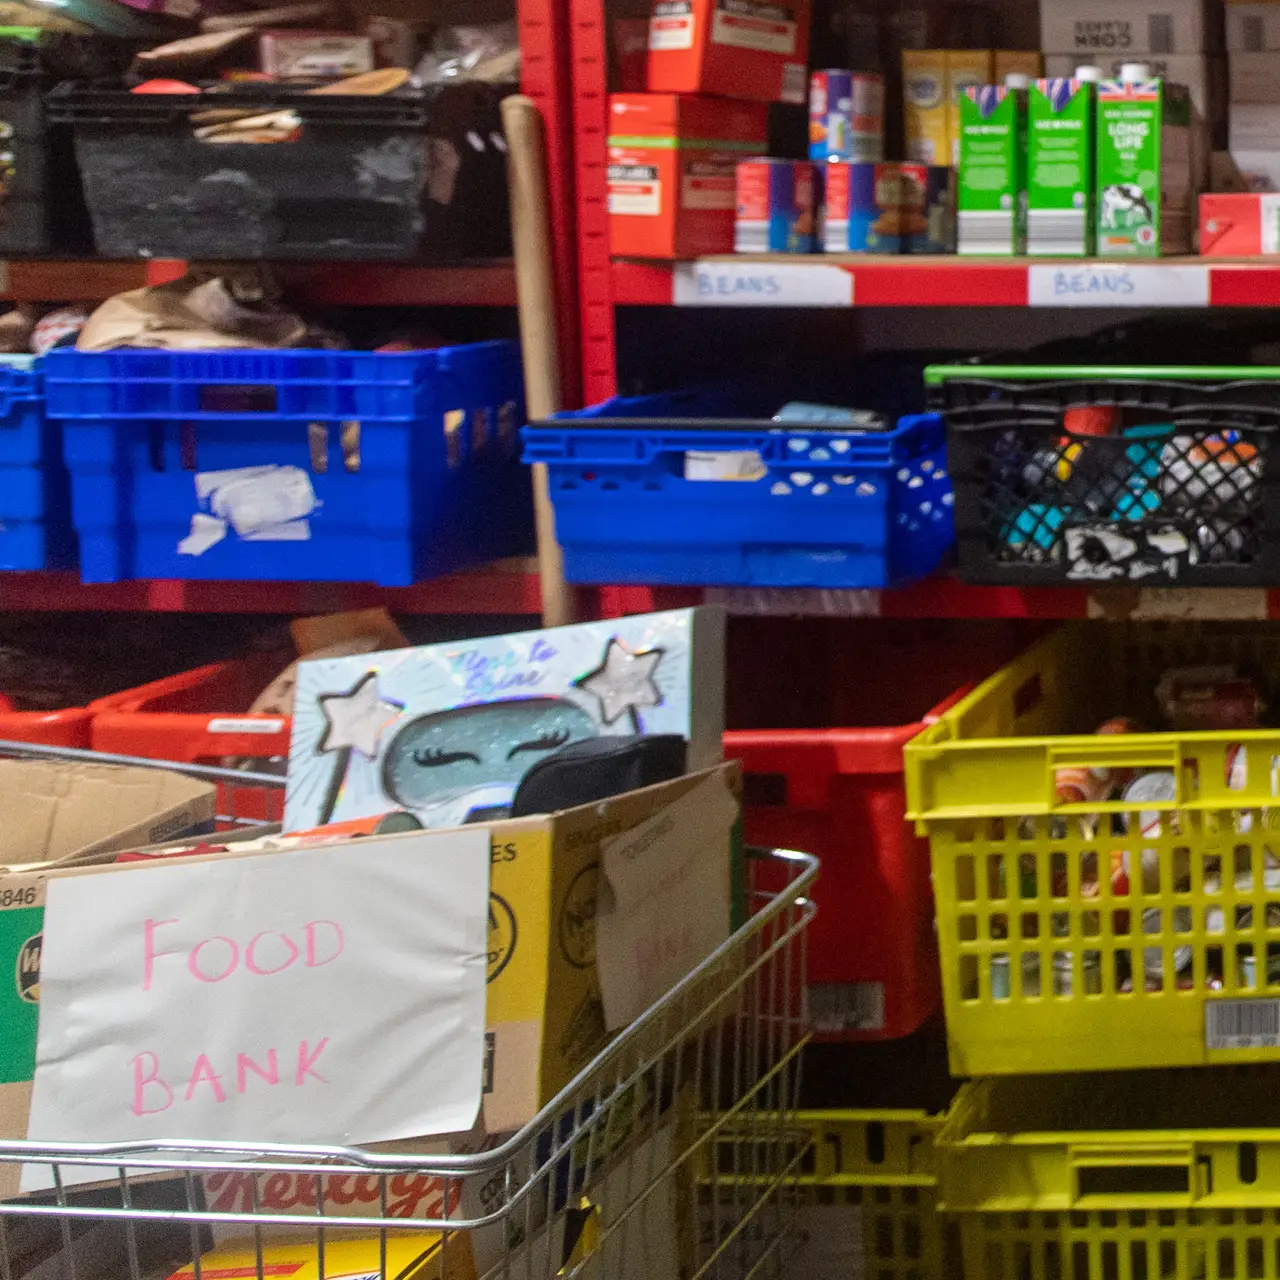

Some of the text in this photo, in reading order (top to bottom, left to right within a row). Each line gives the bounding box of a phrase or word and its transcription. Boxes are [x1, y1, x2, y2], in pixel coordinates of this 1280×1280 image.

[1107, 122, 1148, 138] LONG
[699, 273, 780, 296] BEANS
[1053, 272, 1136, 296] BEANS
[0, 886, 37, 908] 846
[142, 918, 345, 992] FOOD
[126, 1036, 331, 1118] BANK
